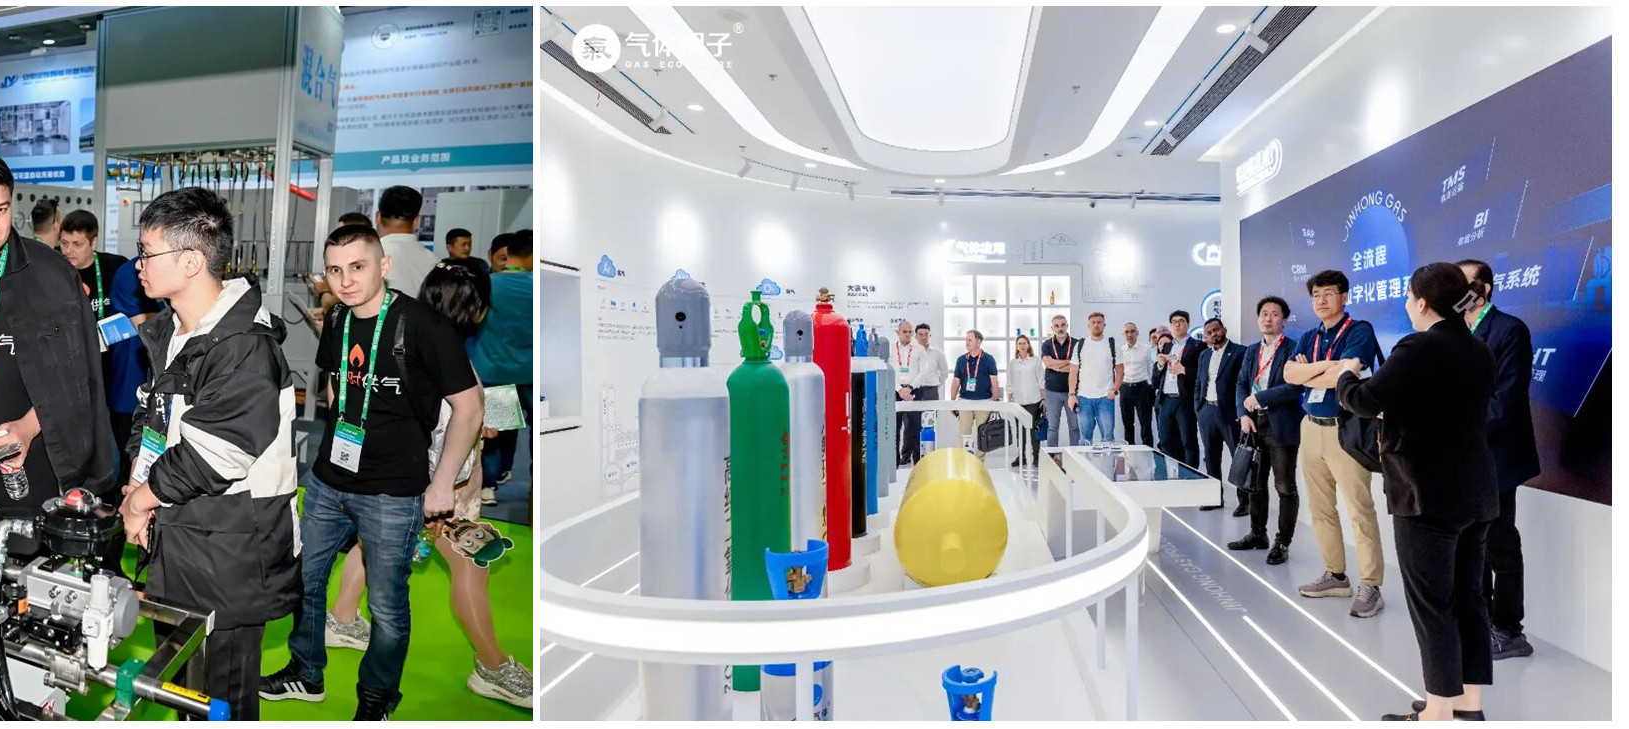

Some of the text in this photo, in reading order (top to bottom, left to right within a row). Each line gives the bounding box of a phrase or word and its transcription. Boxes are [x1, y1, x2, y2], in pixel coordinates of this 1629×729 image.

[1442, 164, 1467, 194] TMS
[1341, 190, 1408, 243] JINHONG GAS
[1473, 208, 1490, 230] BI
[1351, 244, 1388, 272] 全流程
